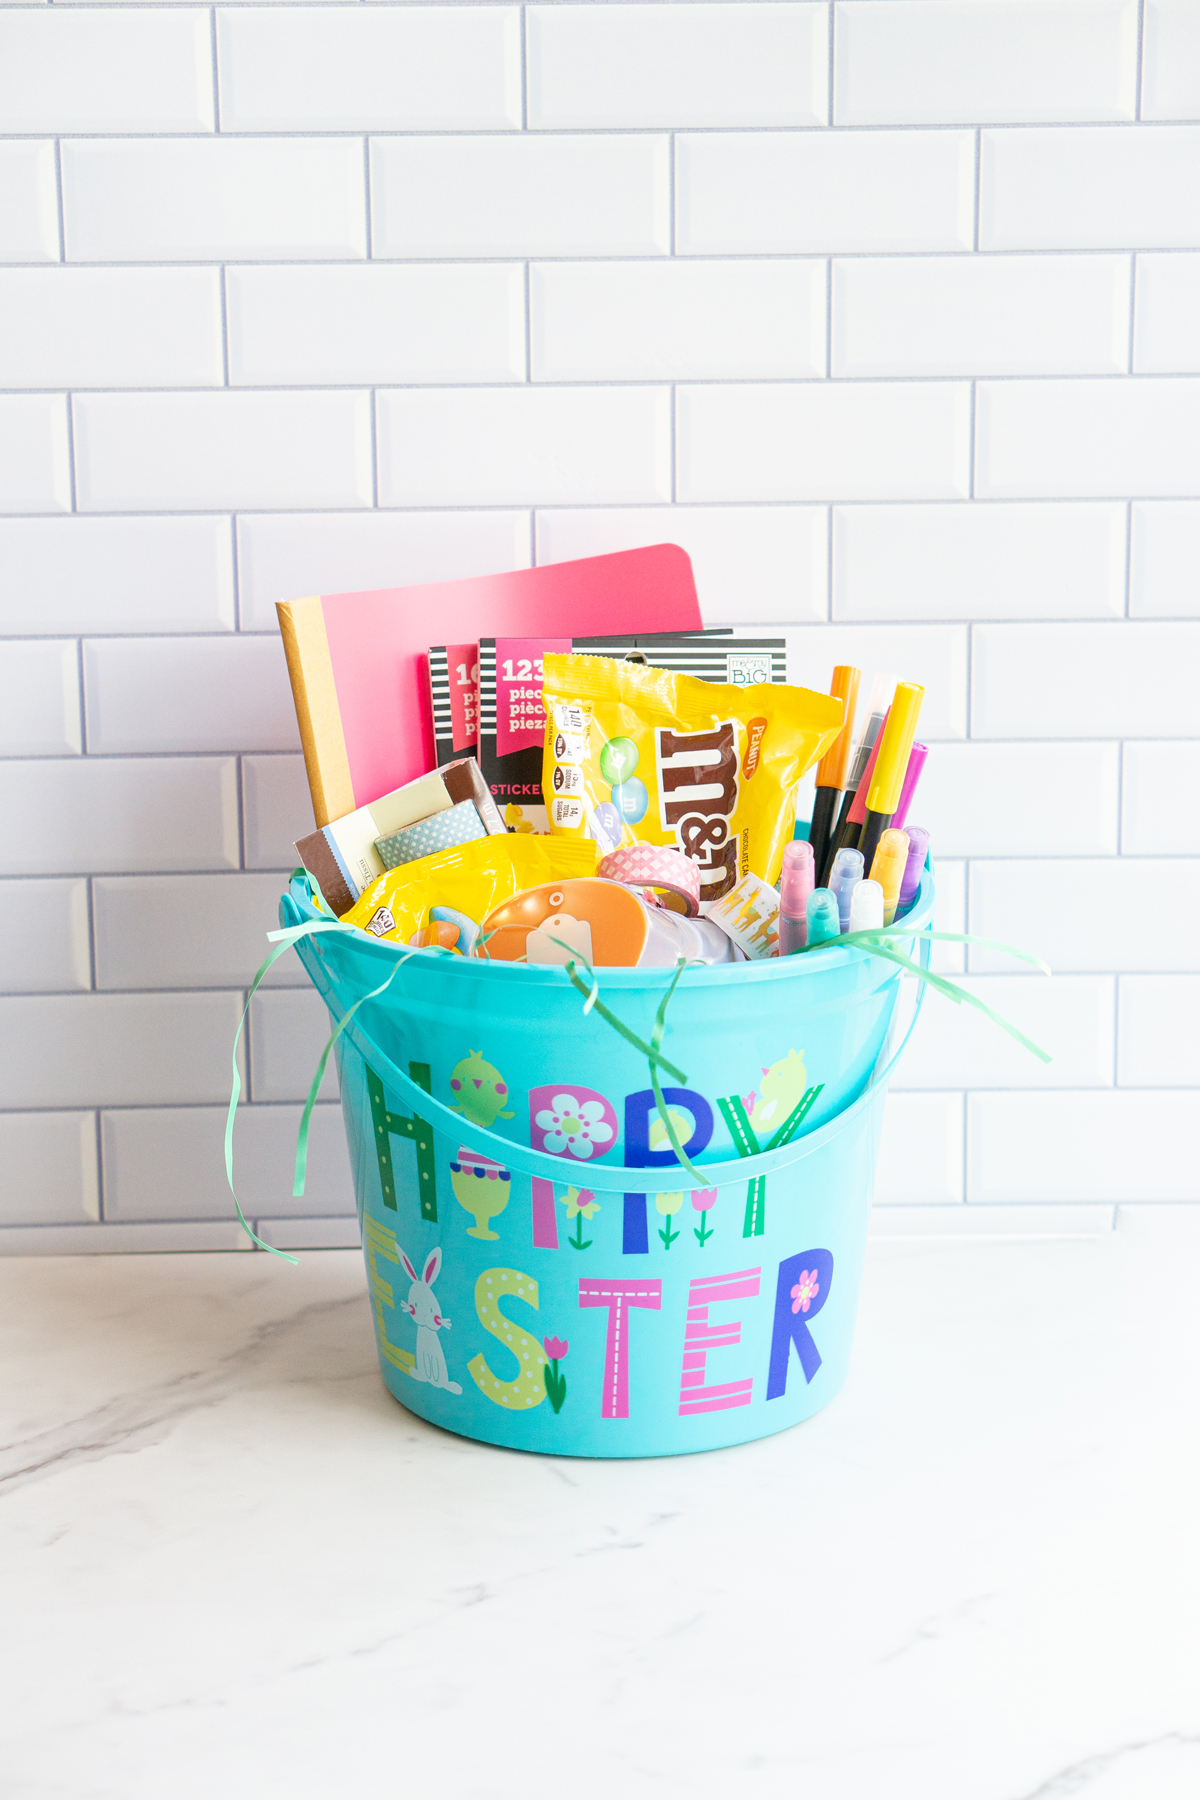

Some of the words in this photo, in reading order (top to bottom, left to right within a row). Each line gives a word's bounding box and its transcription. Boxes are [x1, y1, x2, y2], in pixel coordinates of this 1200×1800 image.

[502, 659, 544, 681] 123
[746, 725, 765, 770] PEANUT
[490, 784, 544, 795] STICKE
[556, 800, 564, 821] SUGARS
[562, 804, 570, 818] TOTAL
